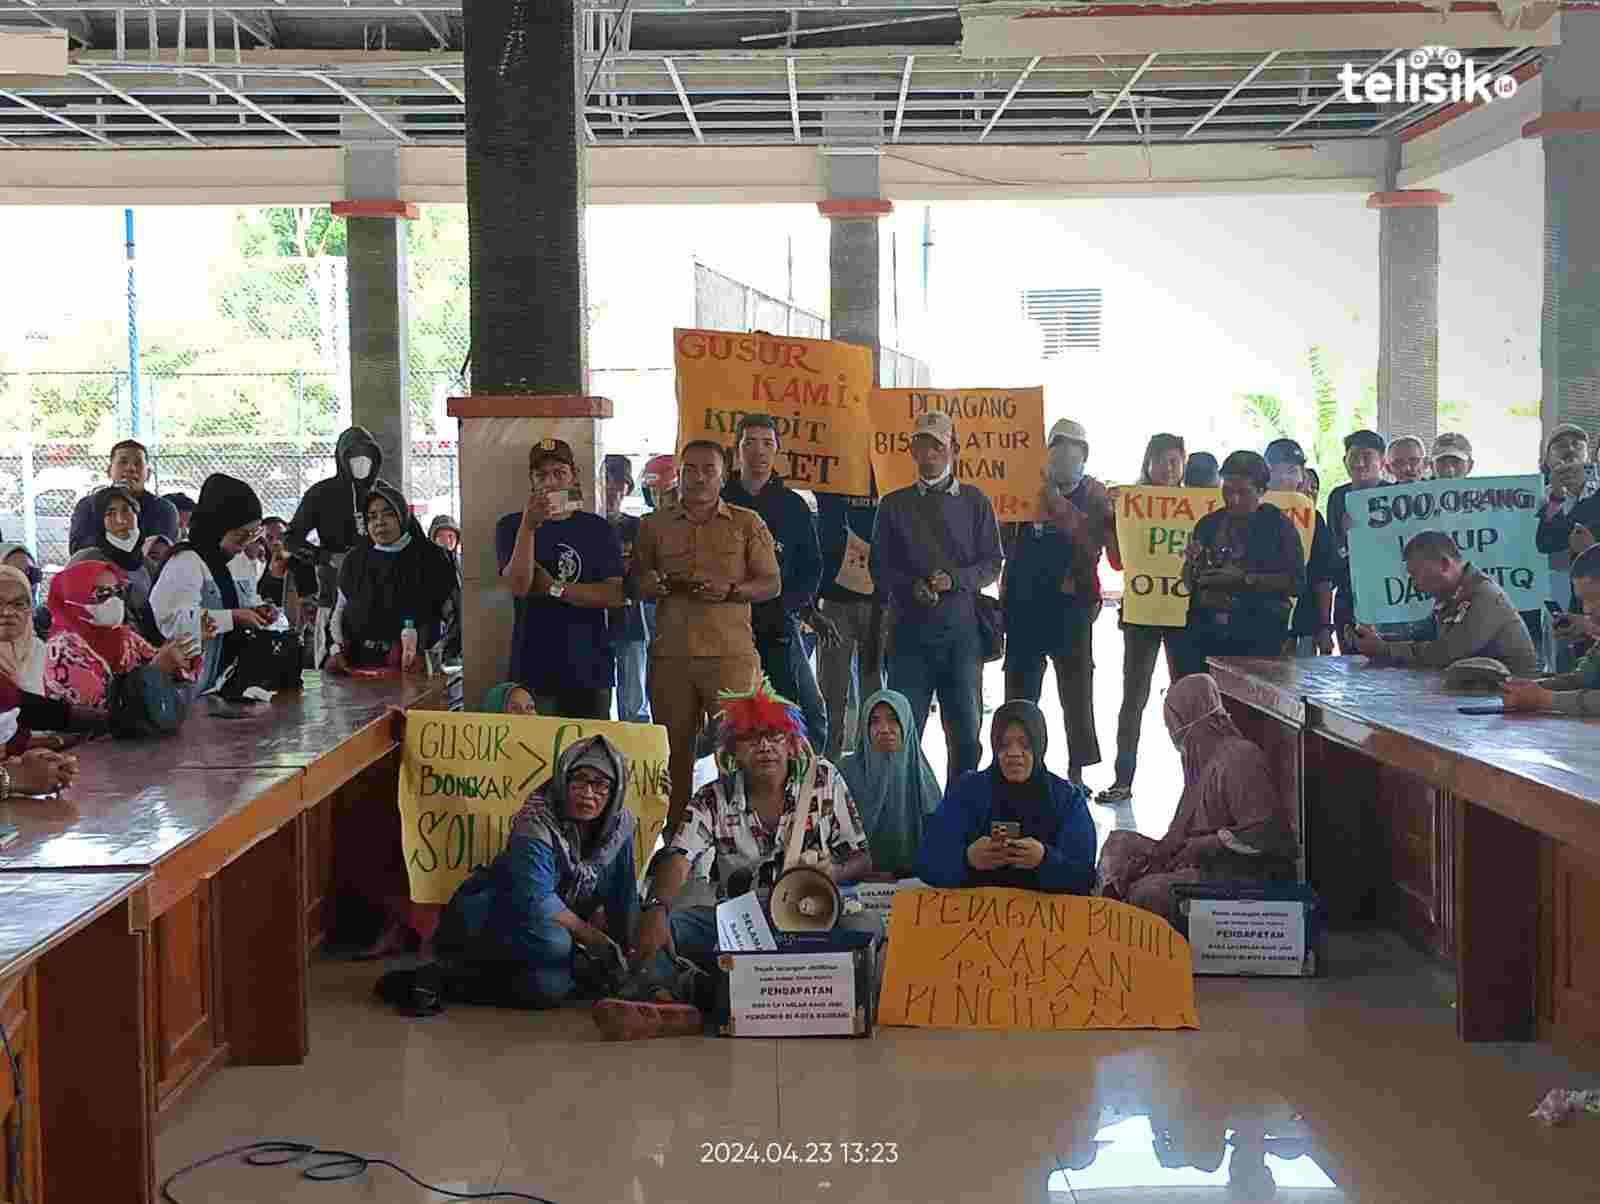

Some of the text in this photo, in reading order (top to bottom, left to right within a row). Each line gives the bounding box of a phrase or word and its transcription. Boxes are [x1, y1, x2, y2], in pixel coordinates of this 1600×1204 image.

[677, 334, 820, 373] GUSUR
[1123, 493, 1195, 522] KITA
[418, 720, 514, 762] GUSUR
[419, 764, 519, 801] BONGKAR
[940, 926, 1134, 994] MAKAN
[759, 985, 834, 997] PENDAPATAN
